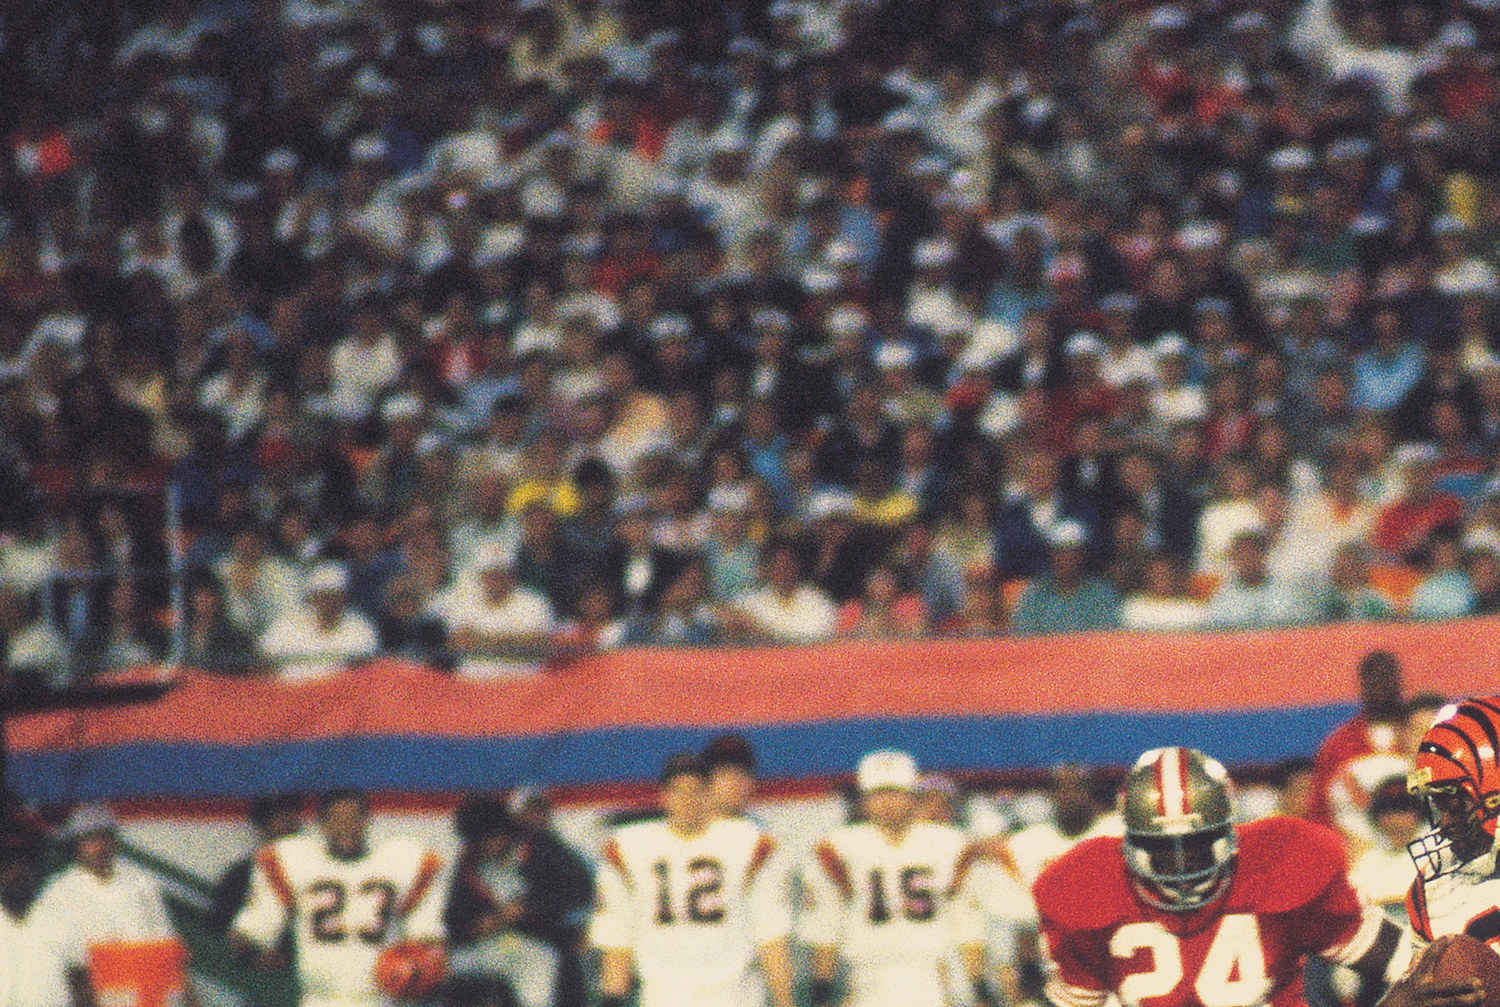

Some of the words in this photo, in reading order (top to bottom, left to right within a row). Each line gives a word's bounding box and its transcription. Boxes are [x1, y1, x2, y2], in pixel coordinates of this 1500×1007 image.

[306, 878, 397, 944] 23
[652, 855, 727, 926] 12
[868, 864, 938, 925] 15
